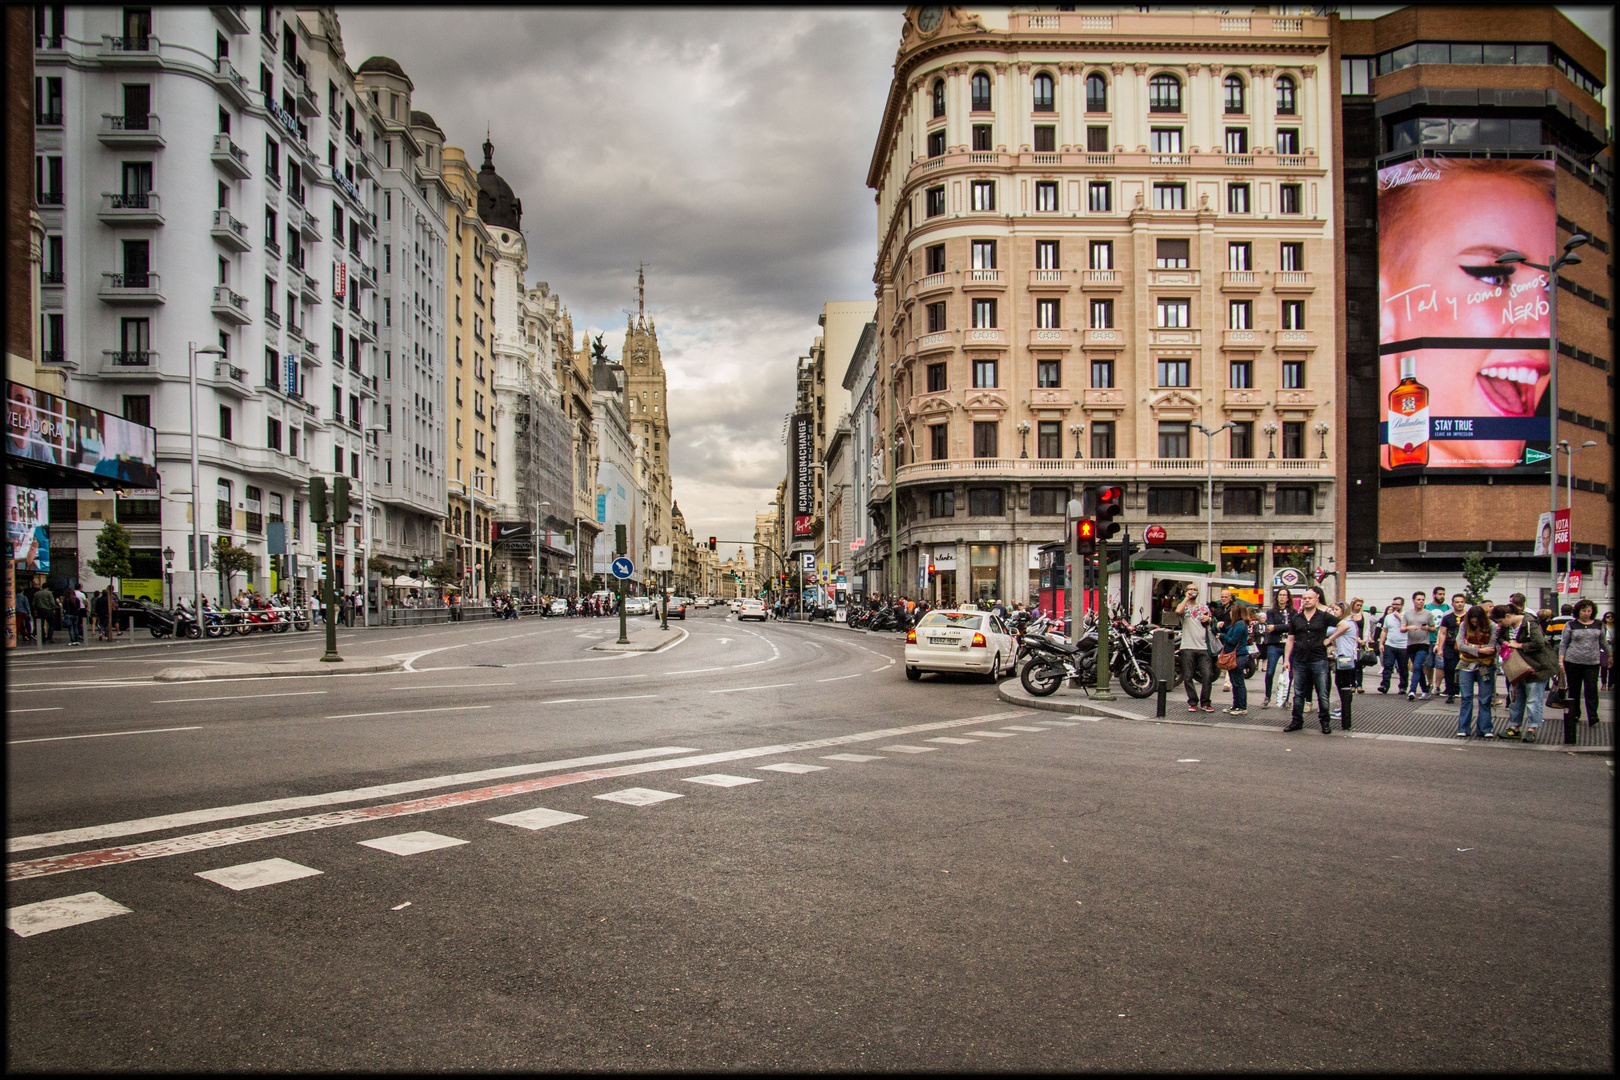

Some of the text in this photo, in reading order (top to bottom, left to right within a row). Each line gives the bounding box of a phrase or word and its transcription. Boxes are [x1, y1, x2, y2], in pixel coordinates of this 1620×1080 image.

[1385, 168, 1441, 189] Ballantine's
[1385, 284, 1437, 321] Tal
[1467, 287, 1502, 304] como
[1435, 419, 1474, 431] STAY TRUE
[799, 421, 807, 512] #CAMPAIGN4CHANGE
[795, 516, 811, 532] Ray-B
[1555, 518, 1569, 531] VOTA
[1555, 531, 1569, 544] PSOE
[804, 555, 815, 568] P
